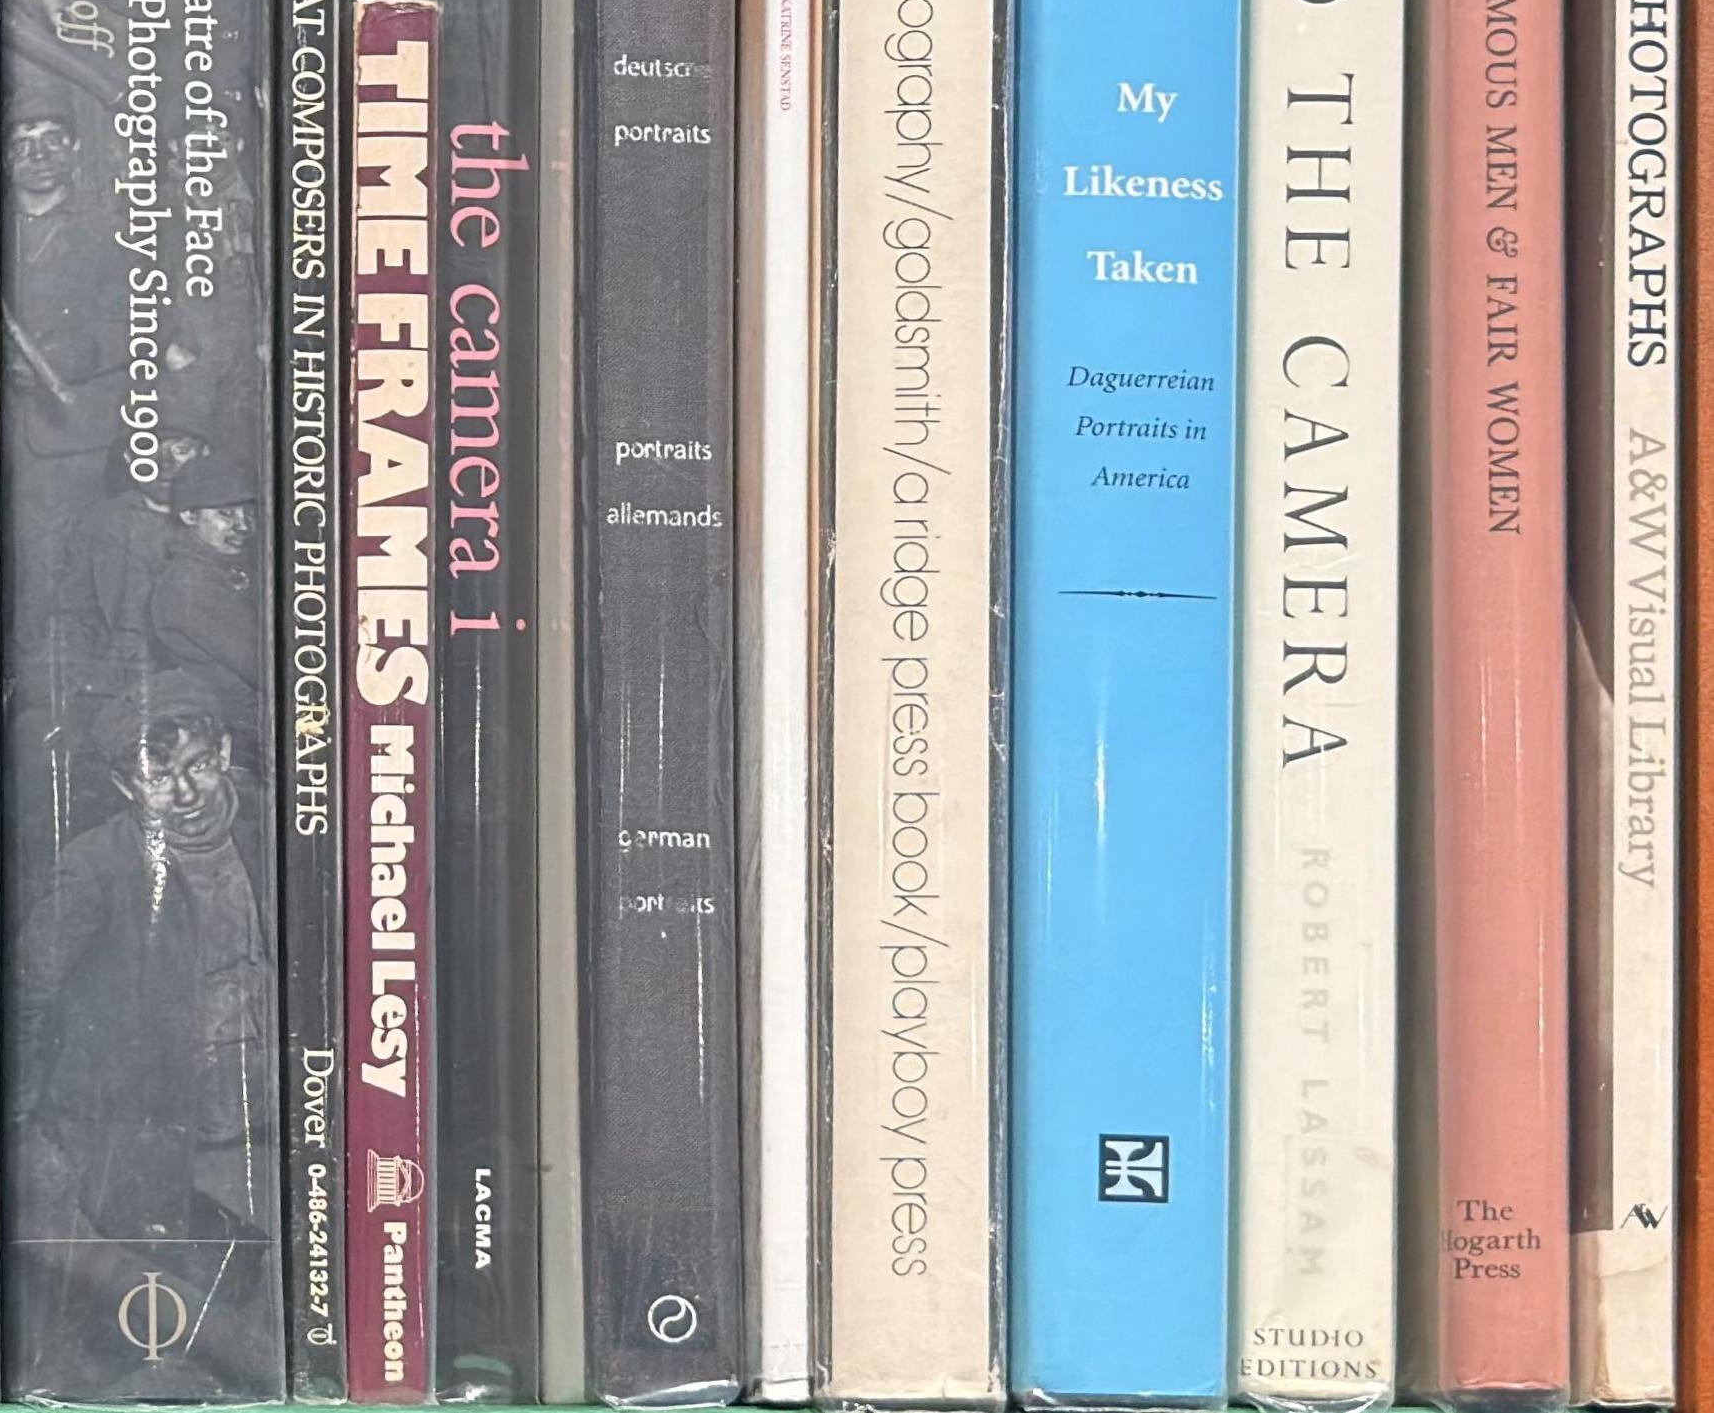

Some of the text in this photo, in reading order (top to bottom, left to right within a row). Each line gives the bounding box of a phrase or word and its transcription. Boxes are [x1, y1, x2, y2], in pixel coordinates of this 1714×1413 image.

[185, 81, 227, 128] of
[613, 121, 712, 146] portraits
[1116, 82, 1177, 122] My
[185, 131, 227, 197] the
[291, 39, 326, 282] COMPOSERS
[449, 120, 530, 249] the
[1063, 167, 1224, 200] Likeness
[1286, 74, 1354, 270] THE
[1486, 126, 1517, 210] MEN
[185, 206, 223, 298] Face
[1088, 251, 1198, 284] Taken
[1487, 227, 1518, 258] &
[291, 291, 326, 337] IN
[1487, 274, 1519, 366] FAIR
[1066, 364, 1215, 396] Daguerreian
[293, 347, 327, 527] HISTORIC
[448, 282, 504, 581] camera
[616, 439, 712, 461] portraits
[1074, 415, 1206, 442] Portraits in
[1488, 382, 1520, 535] WOMEN
[606, 503, 722, 528] allemands
[1091, 465, 1190, 491] America
[1628, 426, 1667, 560] A&W
[356, 40, 430, 1099] TIME FRAMES Michael Lesy
[1281, 336, 1350, 769] CAMERA
[1628, 564, 1667, 706] Visual
[291, 542, 326, 836] PHOTOGRAPHS
[1618, 716, 1667, 888] Library
[301, 1047, 334, 1318] Dover 0-486-24132-7
[474, 1167, 492, 1270] LACMA
[1457, 1200, 1514, 1220] The
[381, 1222, 406, 1382] Pantheon
[1453, 1259, 1520, 1279] Press
[1239, 1360, 1378, 1378] EDITIONS
[1253, 1329, 1364, 1346] STUDIO
